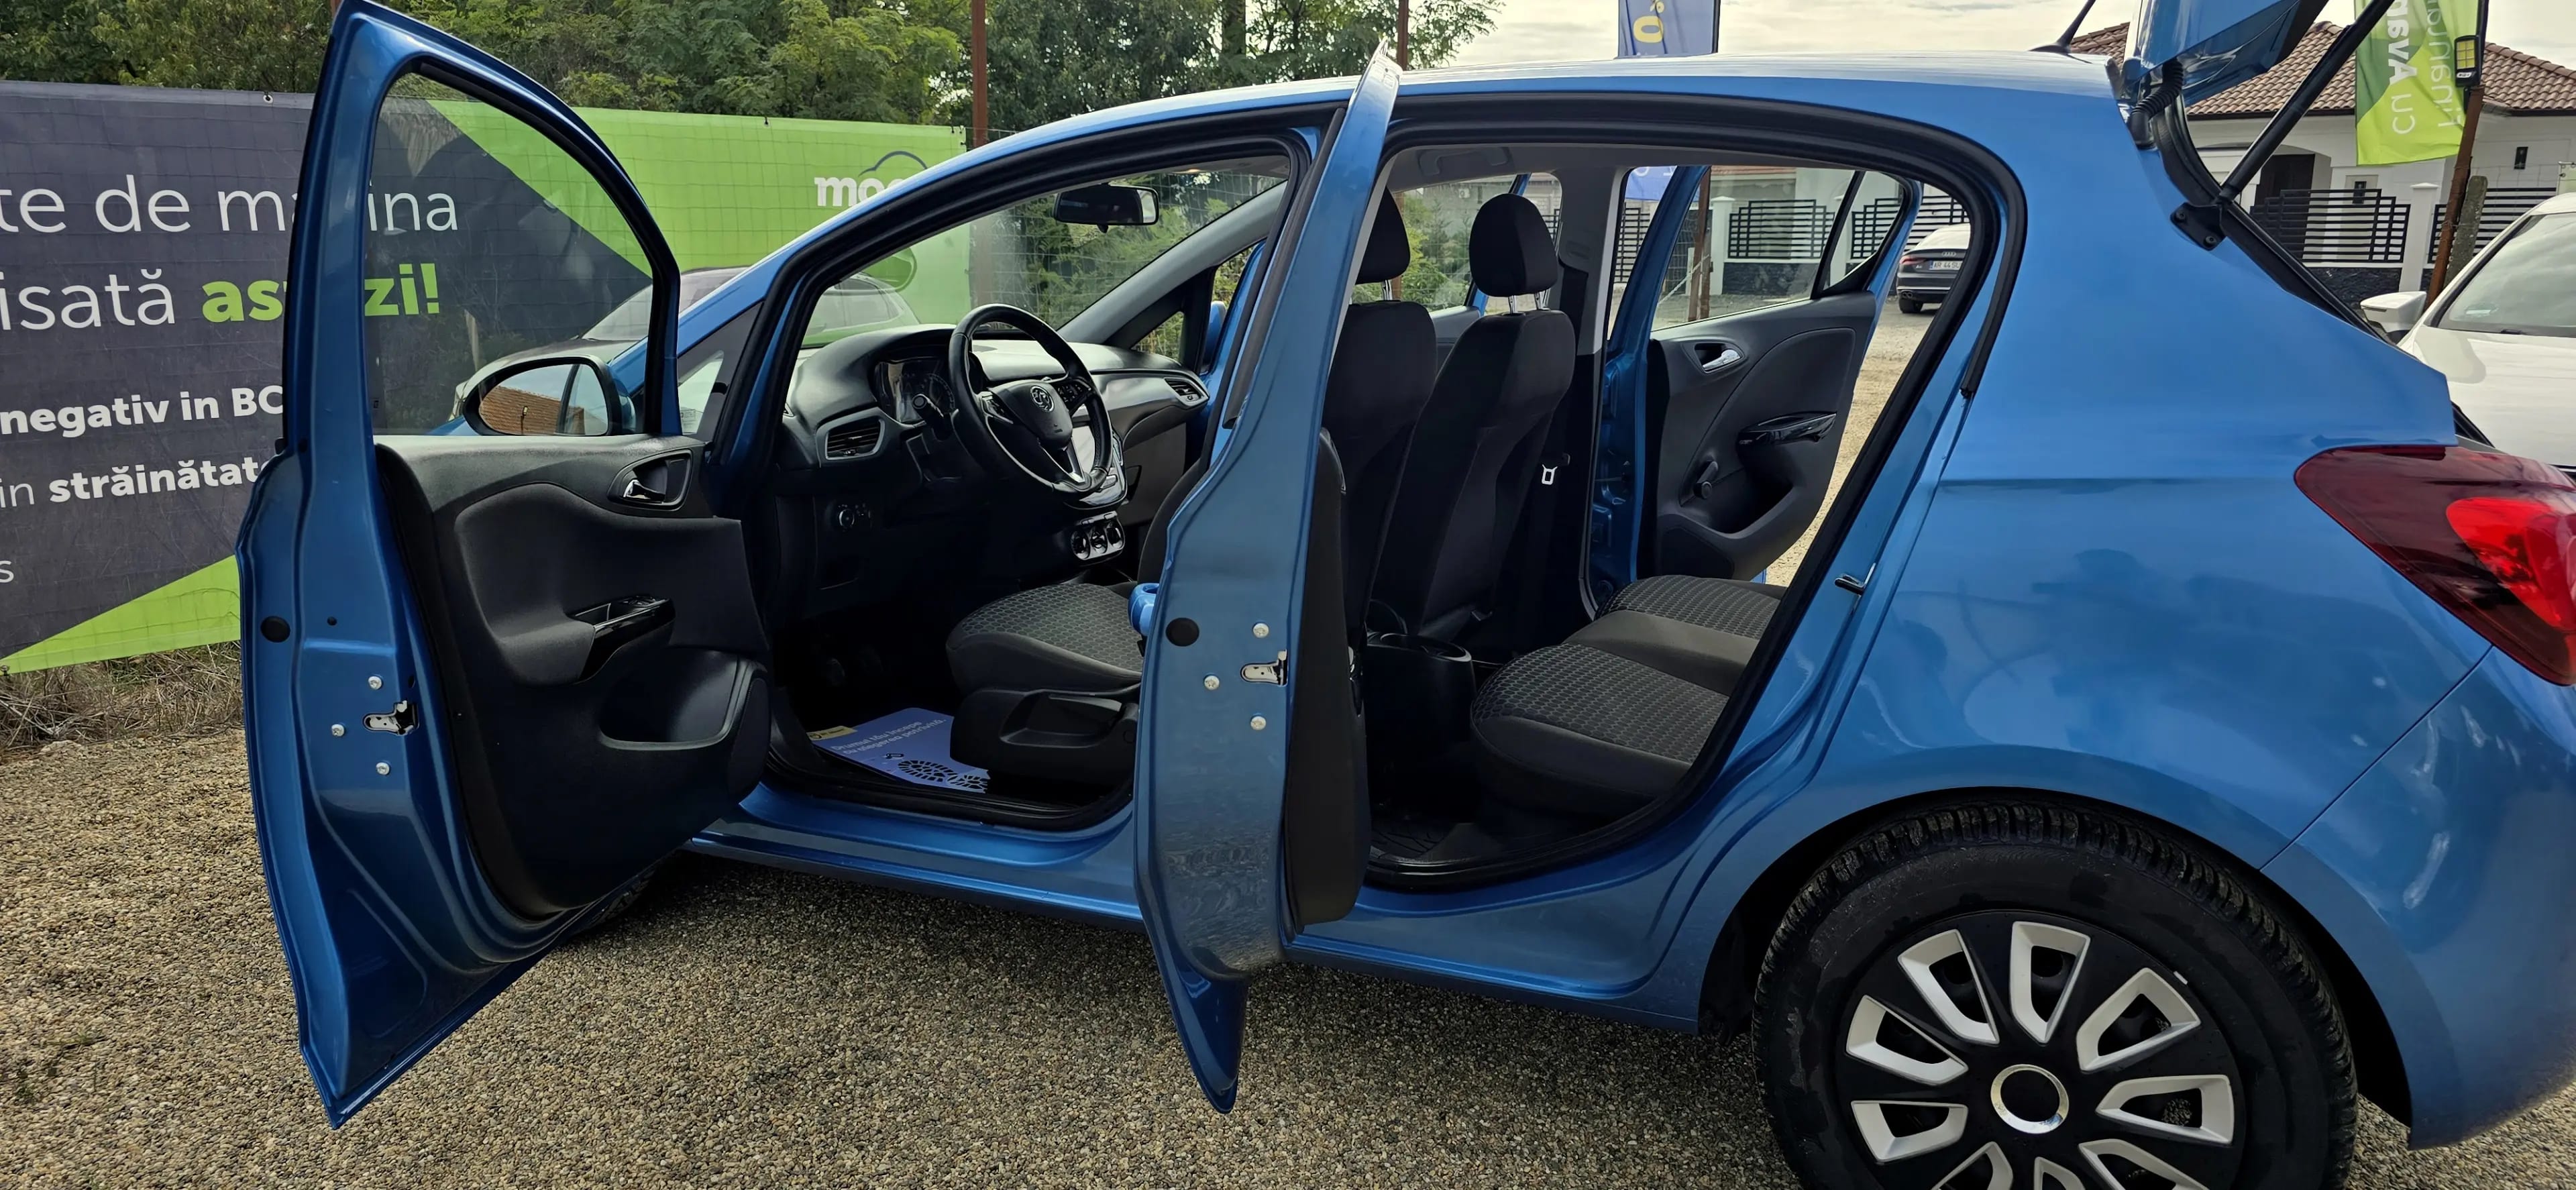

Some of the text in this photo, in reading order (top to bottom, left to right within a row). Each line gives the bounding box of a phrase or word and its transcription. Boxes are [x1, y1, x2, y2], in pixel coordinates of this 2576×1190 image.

[95, 174, 191, 233] de
[217, 179, 458, 232] mina
[814, 176, 906, 207] mo
[0, 263, 440, 331] isată aszi!
[0, 394, 170, 438] negativ
[180, 391, 220, 421] in
[0, 478, 35, 508] in
